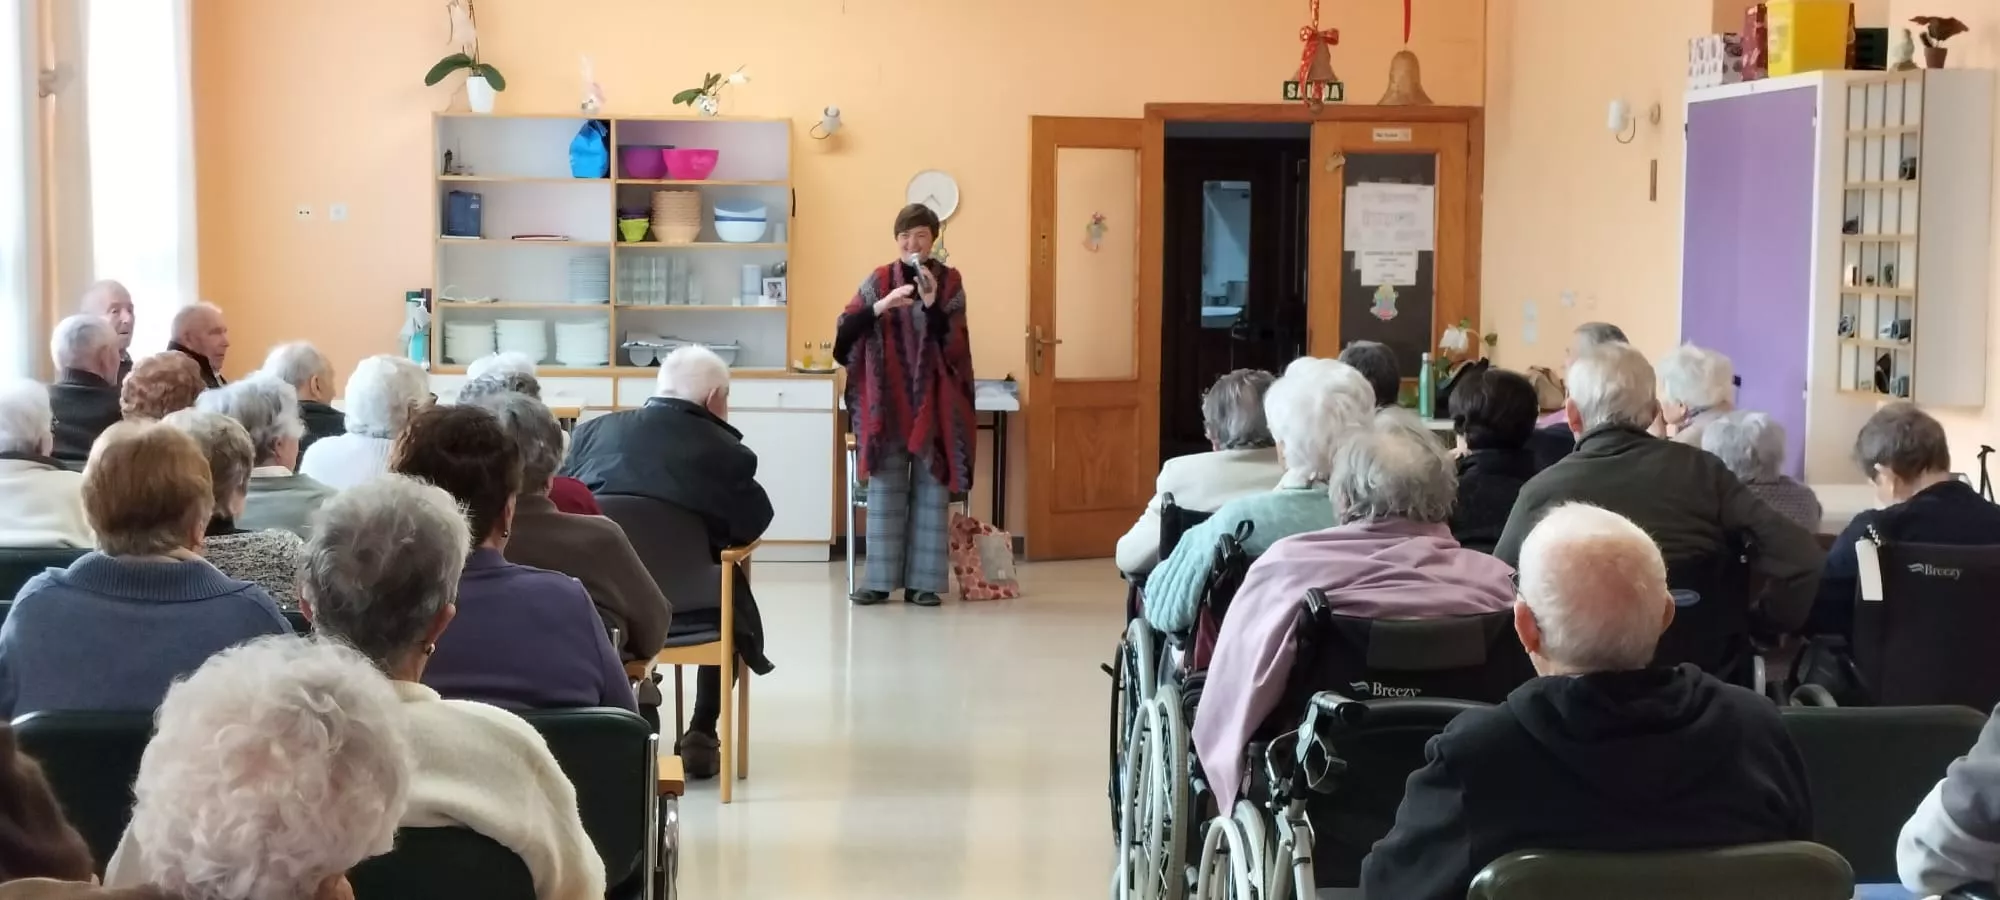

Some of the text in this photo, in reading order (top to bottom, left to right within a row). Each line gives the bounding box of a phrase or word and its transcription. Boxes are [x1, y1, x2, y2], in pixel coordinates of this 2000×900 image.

[1287, 83, 1340, 99] SLDA
[1925, 564, 1961, 580] Breezy
[1372, 682, 1419, 697] Breezy
